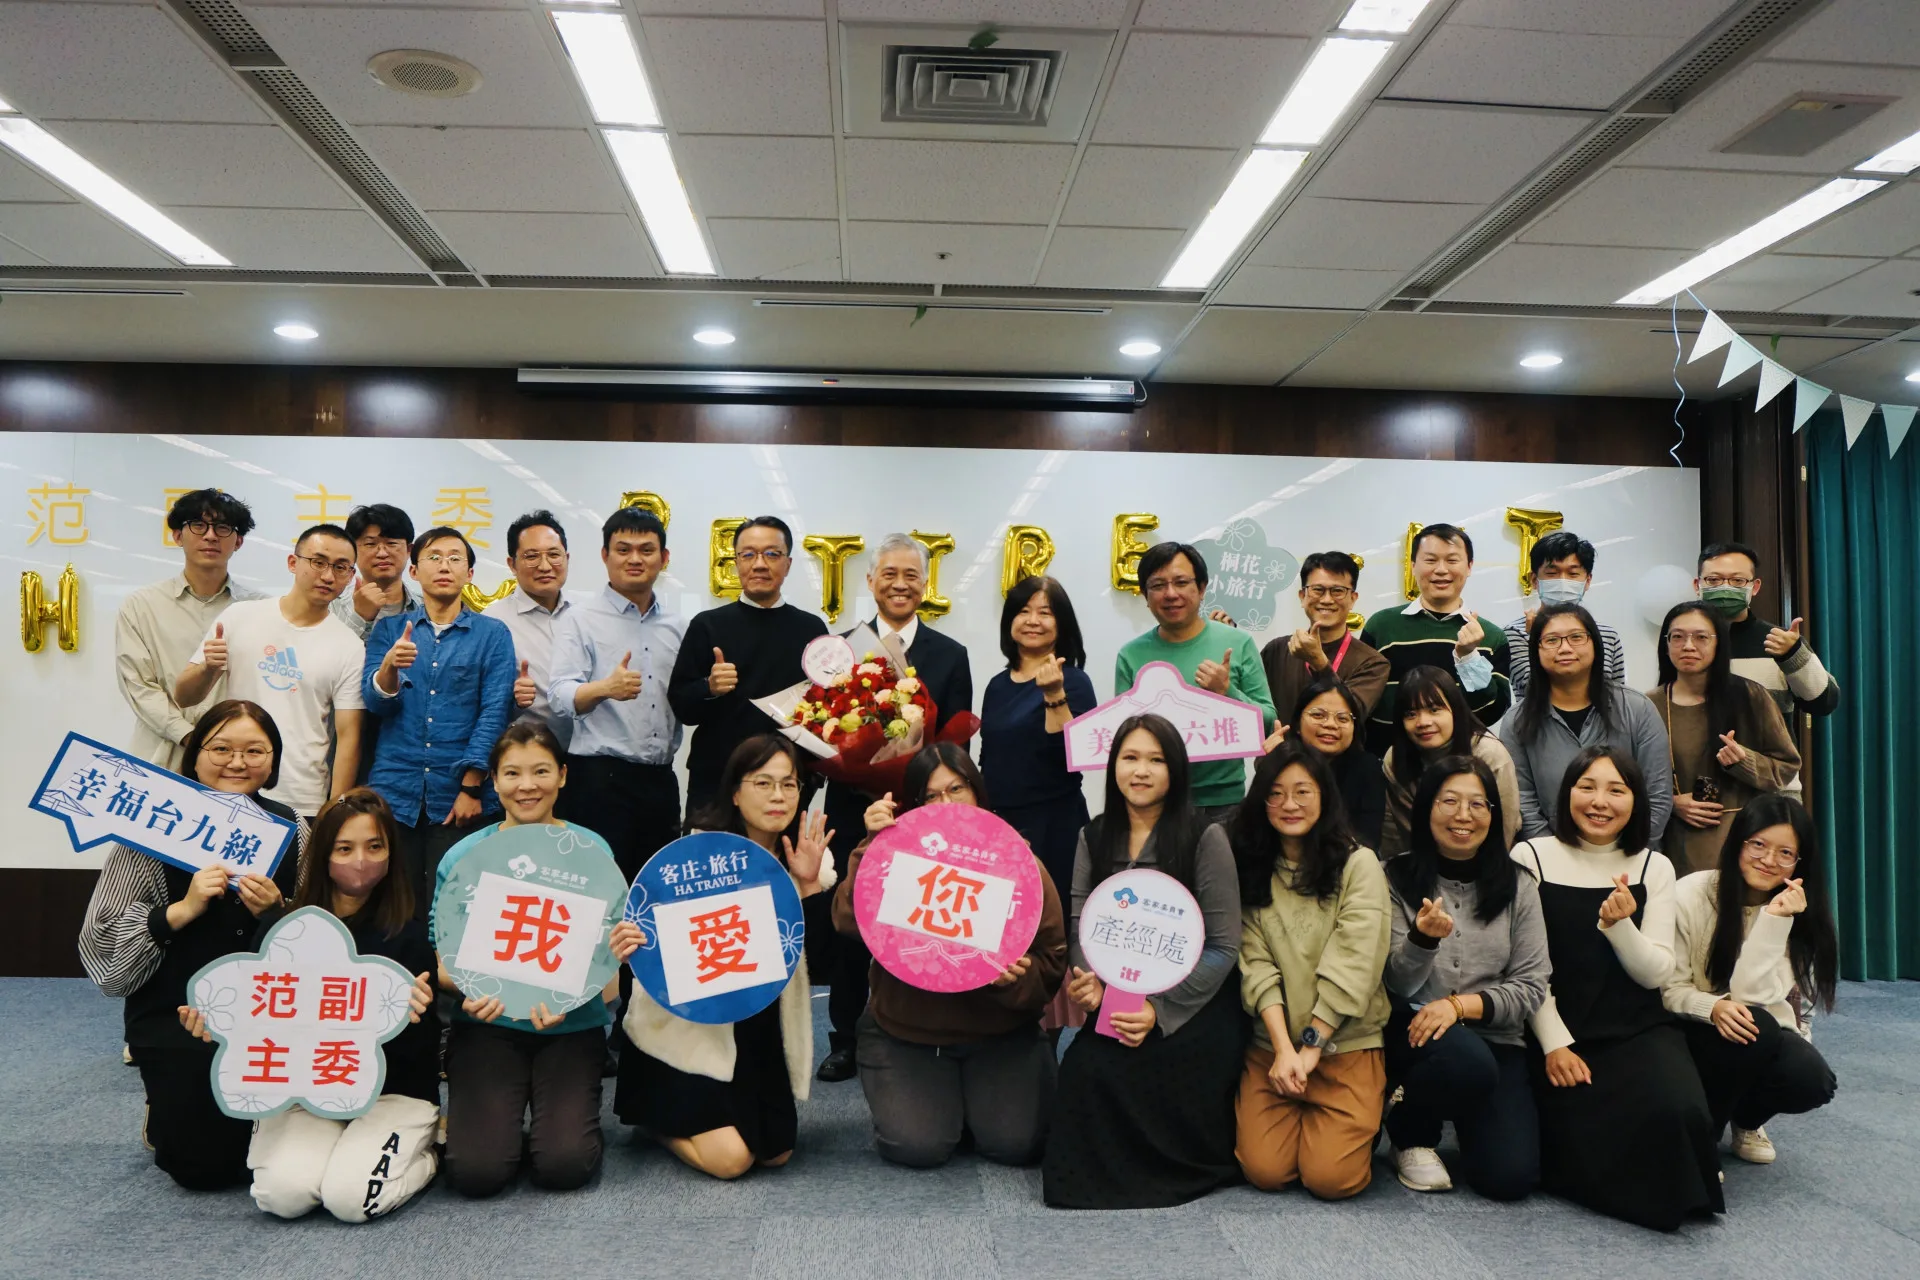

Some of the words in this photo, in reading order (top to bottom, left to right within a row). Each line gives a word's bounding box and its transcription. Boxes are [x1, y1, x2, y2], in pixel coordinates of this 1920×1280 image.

[26, 482, 494, 549] 范主委
[1207, 574, 1268, 600] 小旅行
[1220, 551, 1261, 575] 桐花
[257, 661, 304, 681] adidas
[69, 768, 263, 866] 幸福台九線
[674, 883, 695, 896] HA
[695, 874, 742, 892] TRAVEL
[907, 864, 986, 939] 您
[493, 895, 571, 973] 我
[688, 904, 759, 984] 愛
[1090, 915, 1188, 965] 產經處
[250, 972, 367, 1022] 范副
[242, 1037, 360, 1086] 主委
